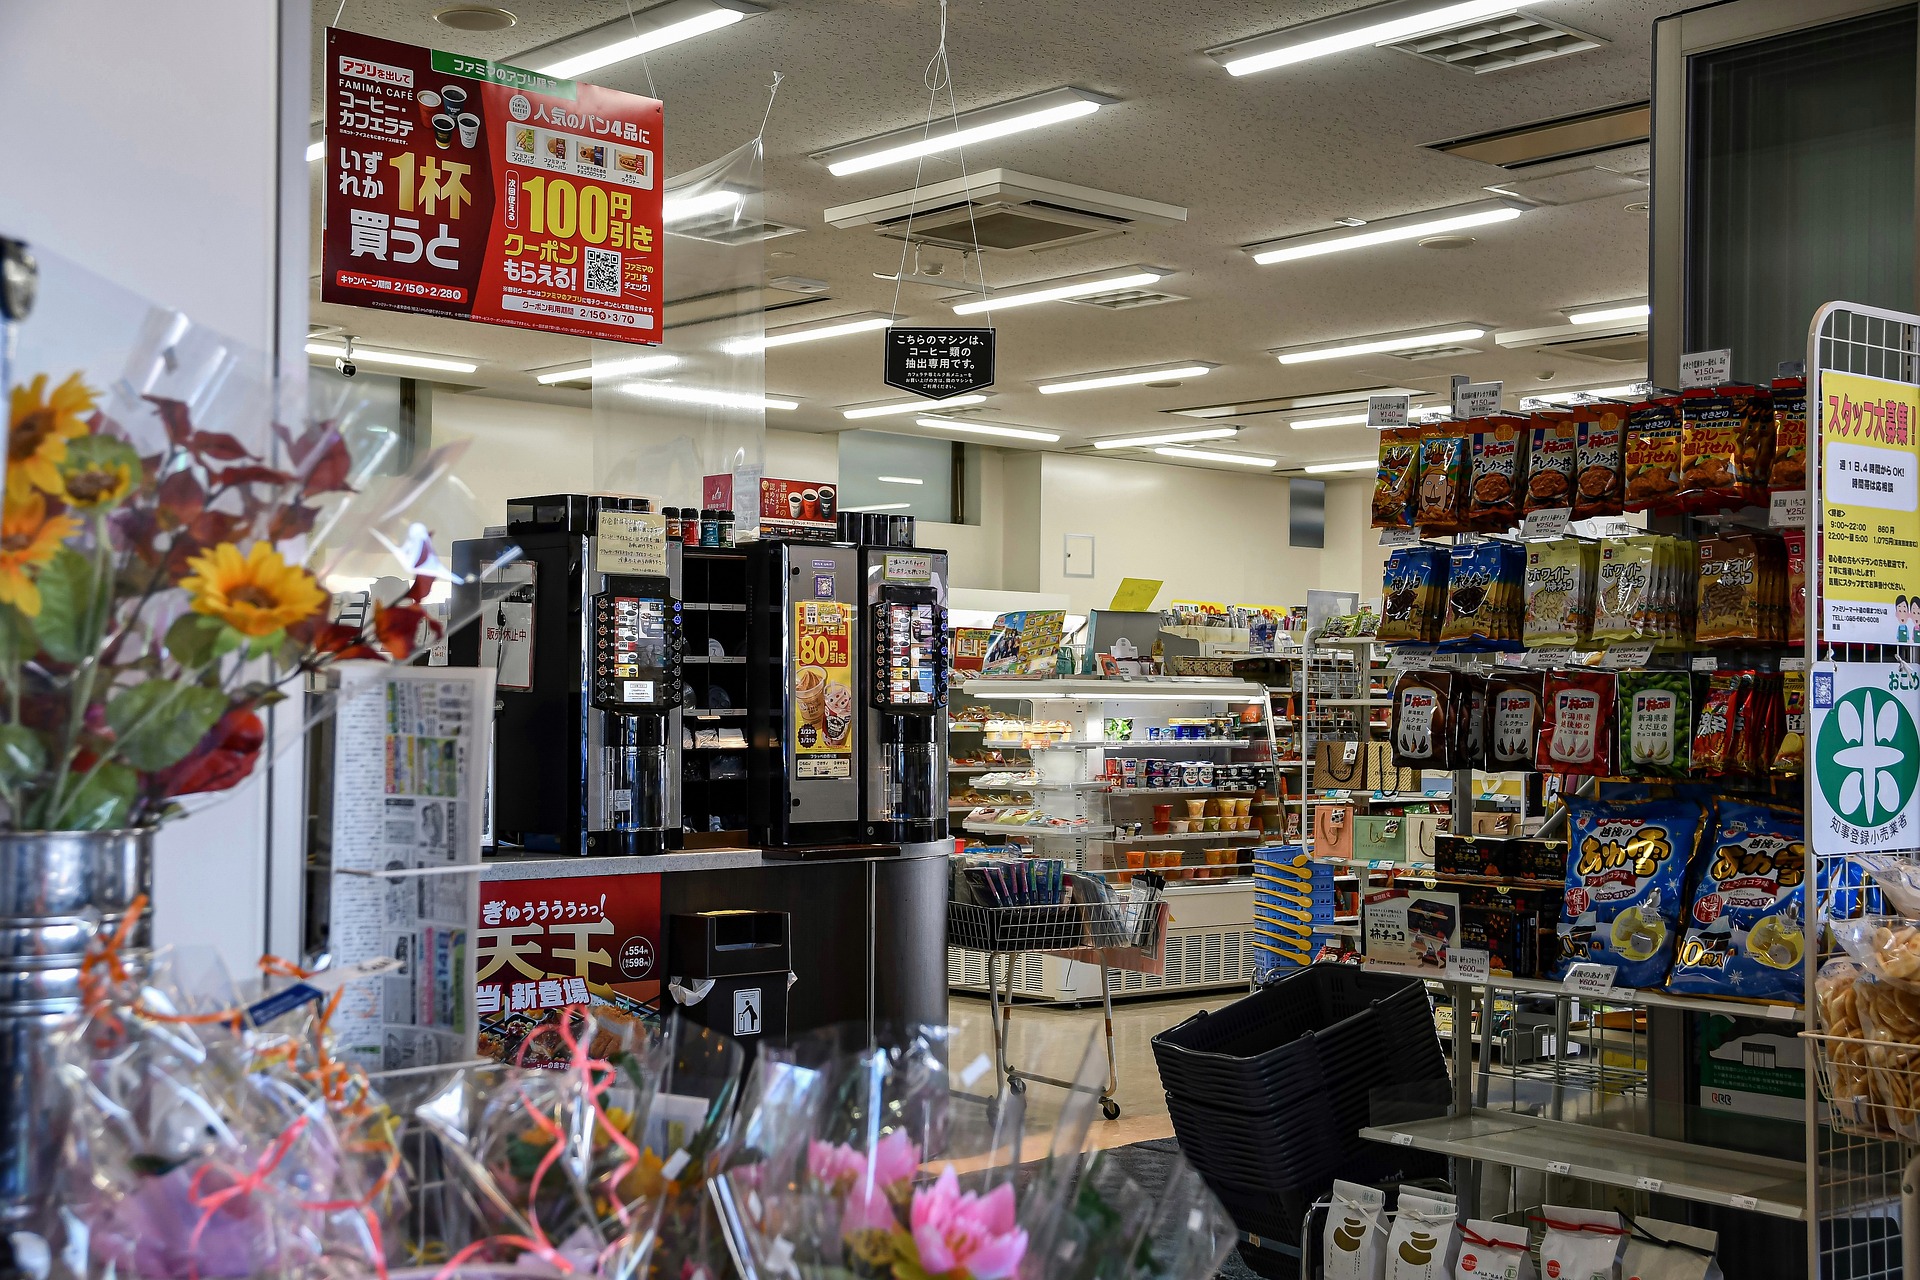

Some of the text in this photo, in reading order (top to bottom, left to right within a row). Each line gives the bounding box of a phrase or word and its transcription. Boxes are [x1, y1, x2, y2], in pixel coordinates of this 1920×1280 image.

[343, 59, 411, 84] アプリを出して
[453, 58, 558, 92] ファミマのアプリ限定
[338, 78, 414, 101] FAMIMA CAFÉ
[339, 109, 414, 137] カフェラテ
[533, 103, 650, 145] 人気のパン4品に
[340, 147, 384, 175] いず
[339, 171, 384, 199] れか
[389, 151, 472, 220] 1杯
[507, 178, 516, 221] 次回使える
[521, 176, 609, 245] 100
[349, 208, 460, 270] 買うと
[504, 233, 578, 264] クーポン
[503, 258, 577, 291] もらえる!
[624, 262, 654, 274] ファミマの
[340, 274, 392, 290] キャンペーン期間
[624, 272, 648, 283] アプリを
[624, 281, 651, 292] チェック!
[522, 301, 575, 316] クーポン利用期間
[896, 334, 984, 346] こちらのマシンは、
[909, 346, 971, 357] コーヒー類の
[905, 357, 975, 369] 抽出専用です。
[1694, 367, 1714, 376] ¥150
[1470, 399, 1488, 407] ¥150
[1701, 410, 1729, 419] せきどり
[1828, 393, 1916, 446] スタッフ大募集!
[1645, 420, 1671, 430] せきどり
[1588, 434, 1619, 449] 柿の種
[1691, 429, 1731, 442] カレー
[1483, 444, 1515, 458] 柿の種
[1543, 441, 1575, 454] 柿の種
[1634, 438, 1674, 452] カレー
[1684, 440, 1736, 457] 揚げせん
[1532, 454, 1572, 469] タレかつ丼
[1578, 449, 1619, 466] タレかつ丼
[1626, 450, 1678, 465] 揚げせん
[1474, 457, 1514, 473] タレかつ丼
[1851, 478, 1894, 493] 時間帯は応相談
[1528, 566, 1570, 581] ホワイト
[1602, 562, 1642, 577] ホワイト
[1701, 558, 1755, 575] カフェオレ
[1545, 579, 1574, 592] 柿チョコ
[1720, 572, 1754, 587] 柿チョコ
[801, 635, 830, 664] 80
[829, 640, 839, 652] 円
[829, 652, 846, 664] 引き
[1411, 695, 1432, 708] 柿の種
[1508, 698, 1530, 711] 柿の種
[1568, 697, 1595, 710] 柿の種
[1645, 699, 1671, 712] 柿の種
[1402, 716, 1428, 724] ミルクチョコ
[1561, 711, 1591, 721] 新潟県産
[1638, 713, 1668, 722] 新潟県産
[1503, 727, 1521, 735] 柿の種
[1638, 723, 1668, 731] えだ豆の
[1600, 826, 1633, 838] 越後の
[1830, 812, 1908, 846] 知事登録小売業者
[1748, 838, 1783, 849] 越後の
[1369, 927, 1406, 942] 柿チョコ
[1459, 964, 1476, 972] ¥600
[1570, 970, 1611, 981] 越後のあわ雪
[1578, 978, 1598, 987] ¥600
[511, 977, 590, 1010] 新登場
